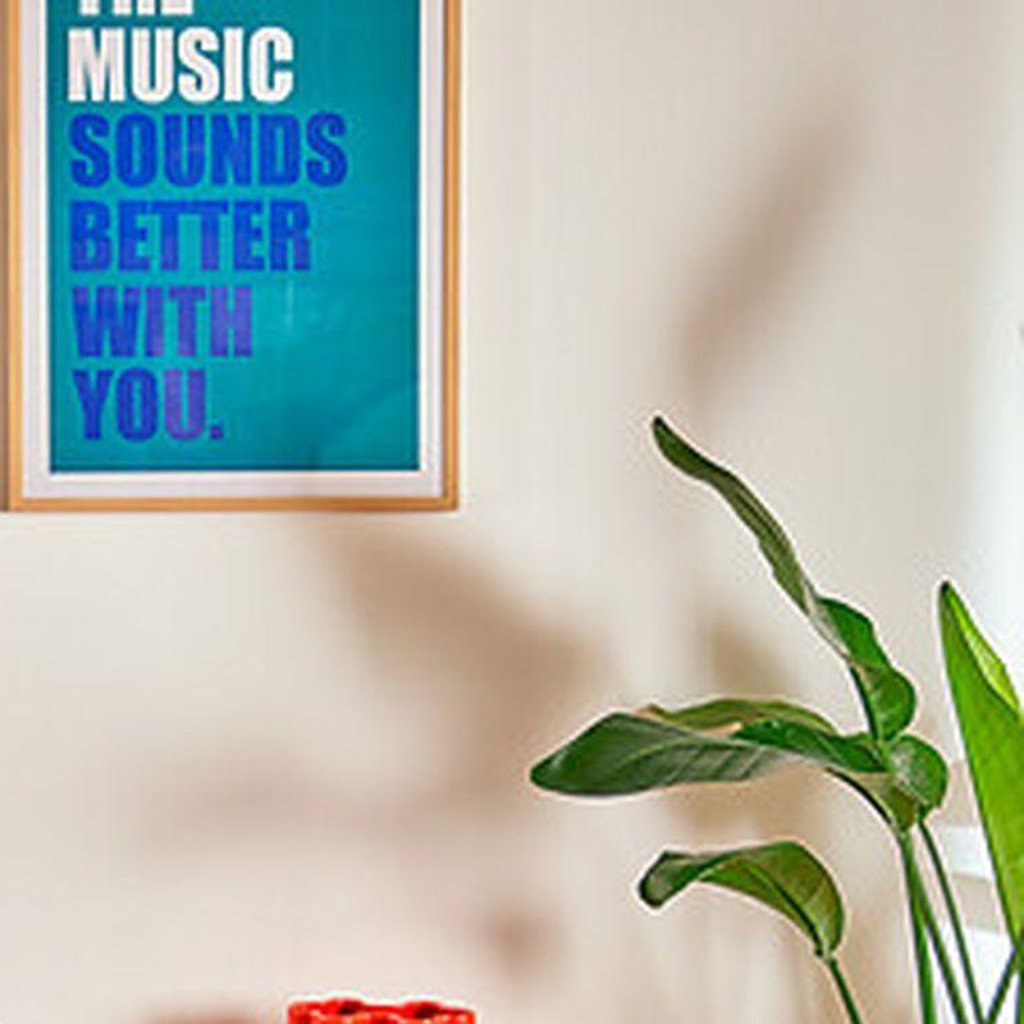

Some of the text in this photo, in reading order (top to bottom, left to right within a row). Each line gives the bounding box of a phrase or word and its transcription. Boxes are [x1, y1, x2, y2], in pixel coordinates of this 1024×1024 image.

[67, 26, 294, 103] MUSIC
[69, 112, 348, 187] SOUNDS
[69, 200, 311, 271] BETTER
[73, 286, 253, 358] WITH
[73, 368, 224, 441] YOU.
